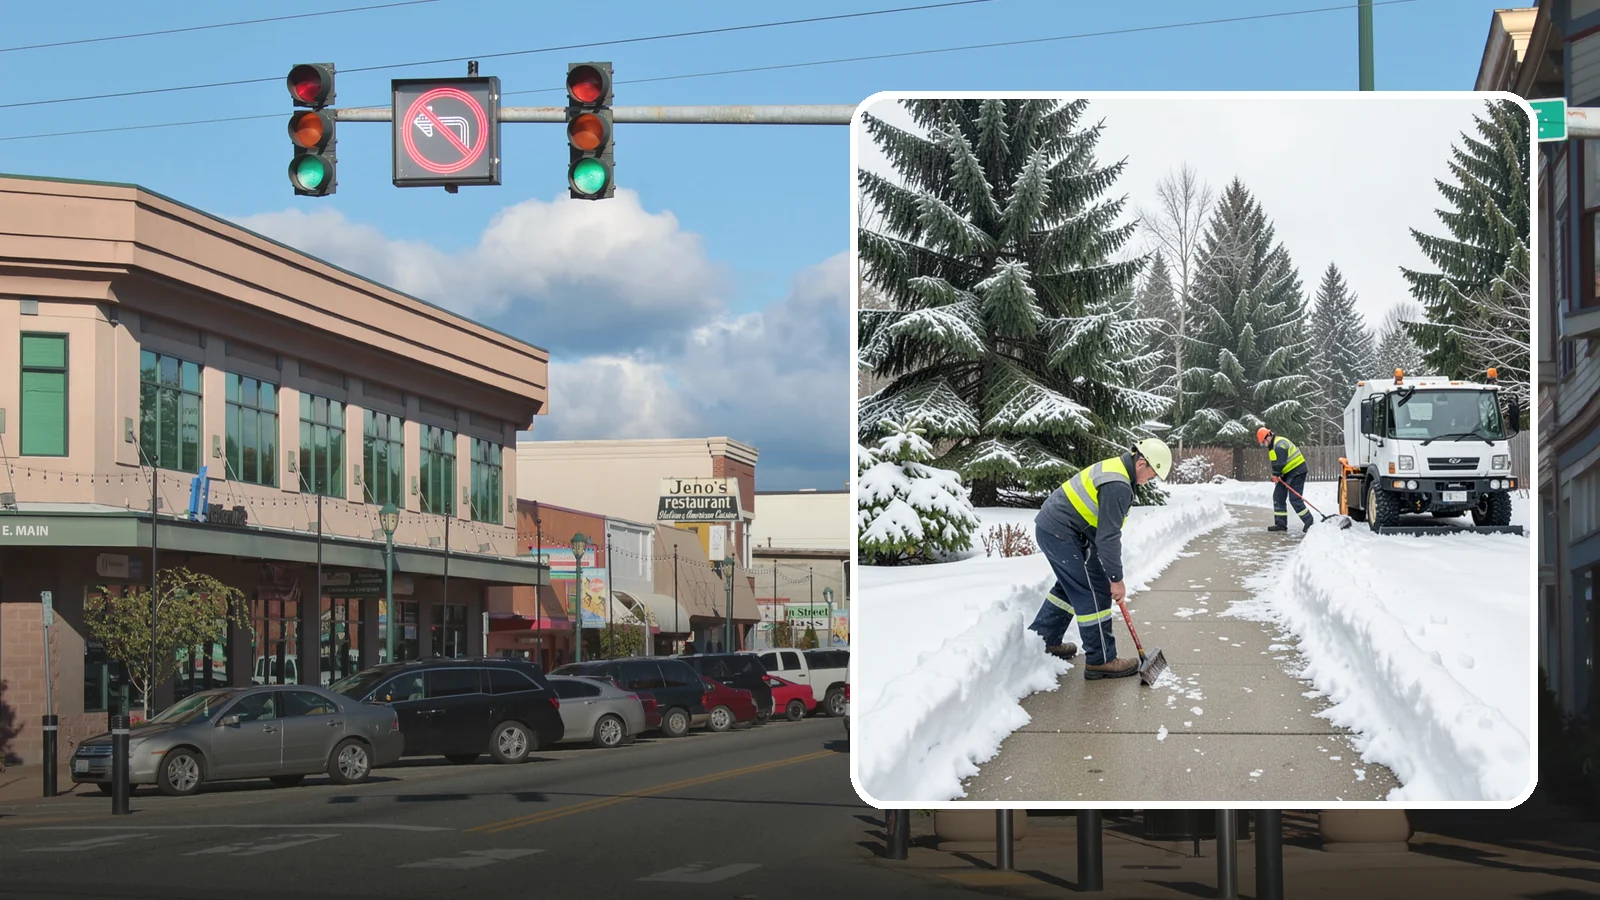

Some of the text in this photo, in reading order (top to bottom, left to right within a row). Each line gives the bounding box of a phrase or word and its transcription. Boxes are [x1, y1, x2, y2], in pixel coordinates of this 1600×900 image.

[670, 480, 727, 494] Jeno's
[665, 496, 731, 509] restaurant
[659, 510, 682, 520] Italian
[686, 510, 715, 519] American
[715, 509, 738, 519] Cuisine
[2, 525, 49, 536] E. MAIN
[797, 608, 828, 616] Street
